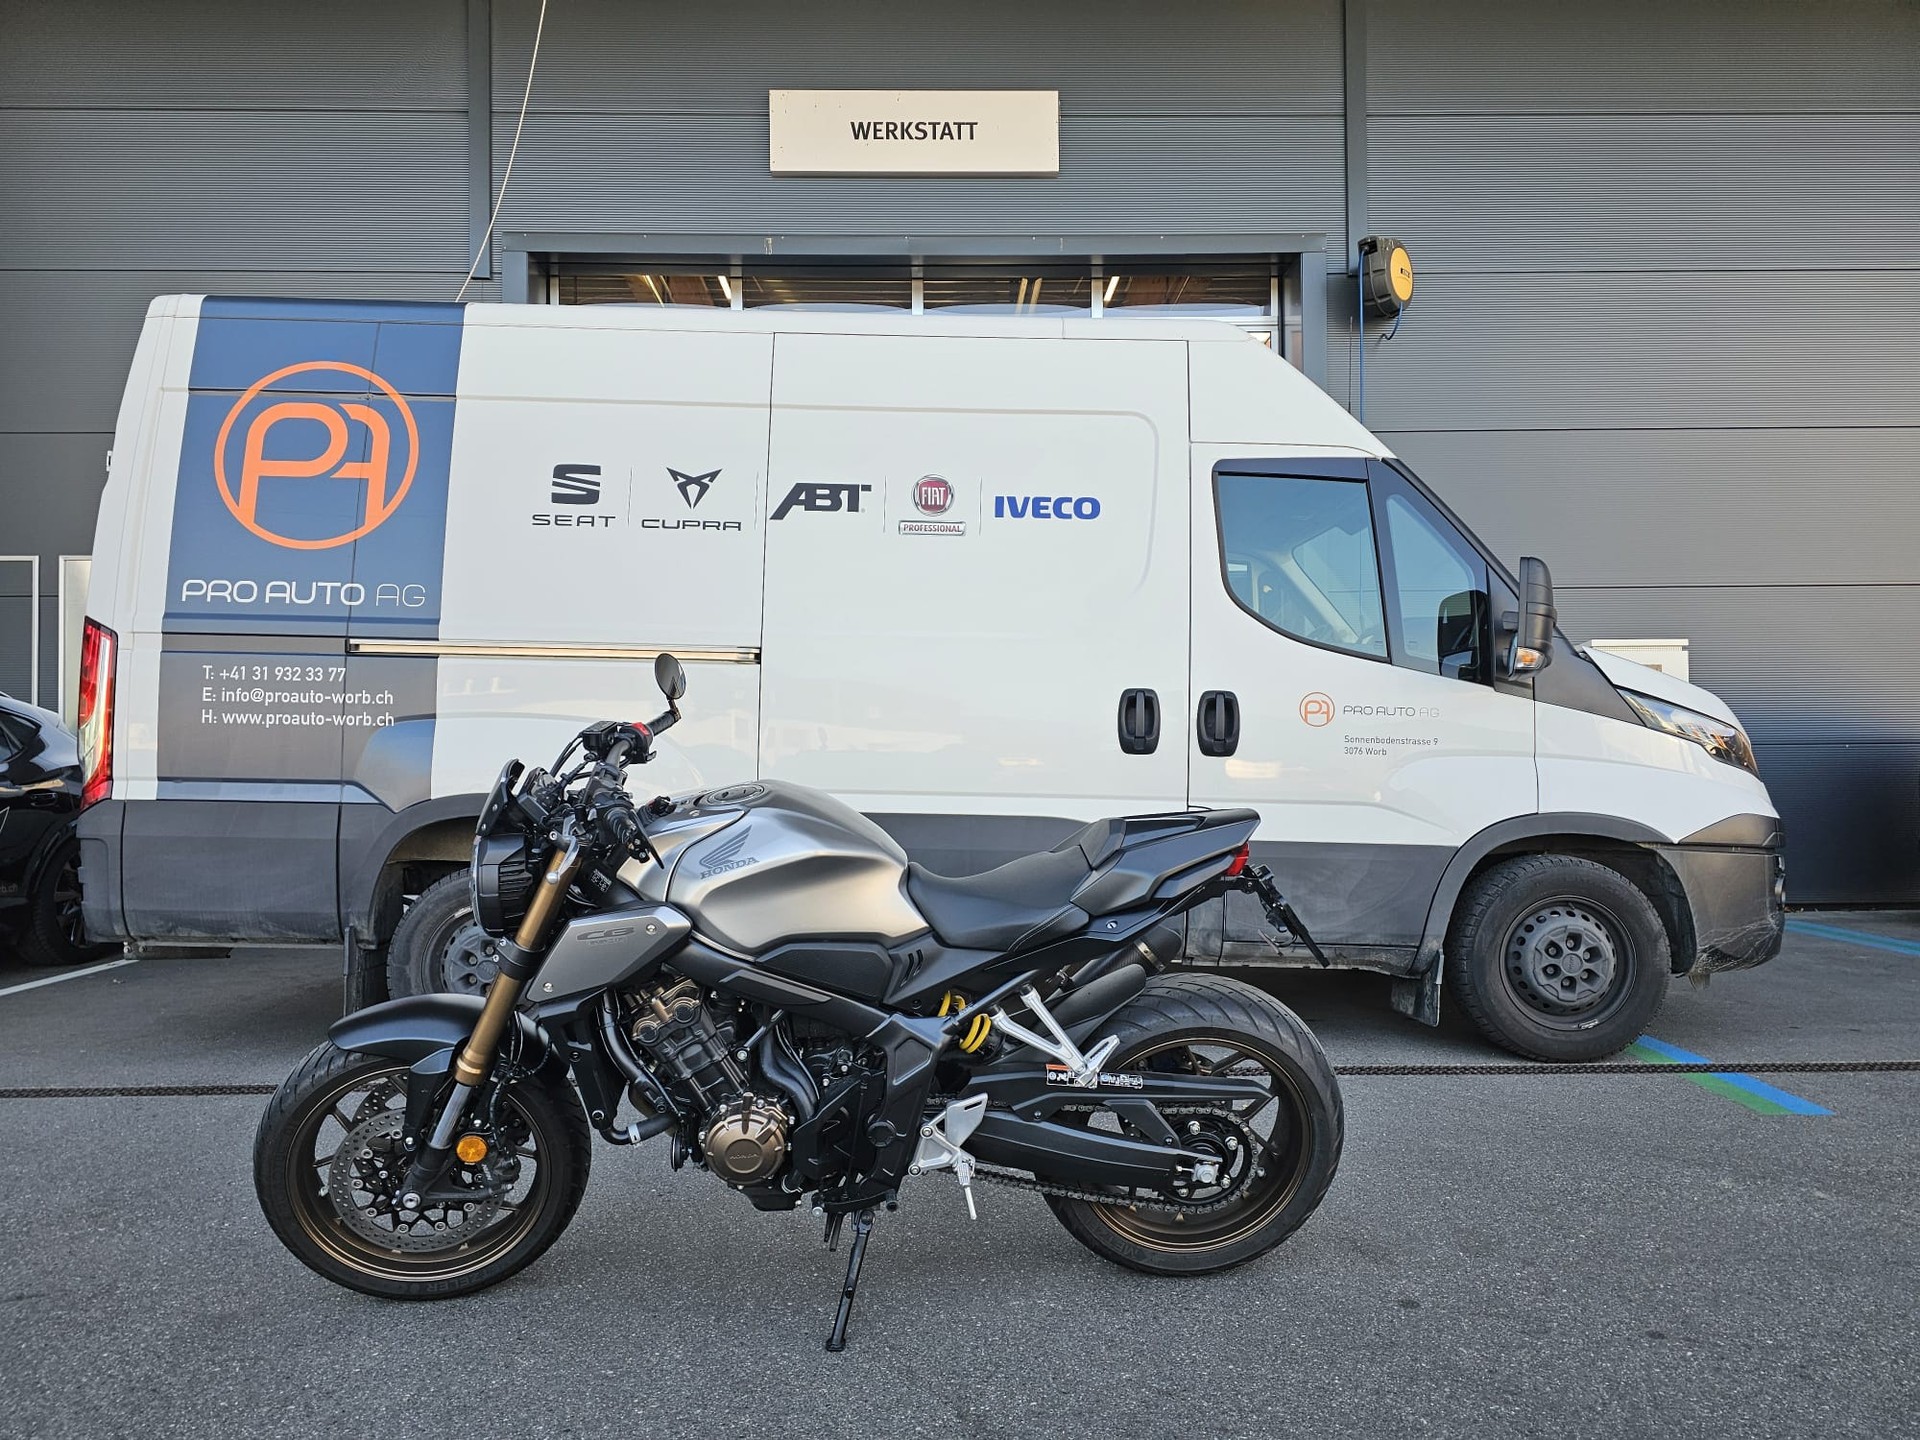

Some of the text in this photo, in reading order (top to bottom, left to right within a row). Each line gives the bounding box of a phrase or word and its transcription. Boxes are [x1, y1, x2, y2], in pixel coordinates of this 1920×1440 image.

[850, 121, 978, 140] WERKSTATT
[769, 482, 872, 520] ABT
[921, 486, 946, 506] FIAT
[994, 495, 1101, 520] IVECO
[531, 514, 617, 528] SEAT
[641, 518, 742, 531] CUPRA
[903, 524, 963, 533] PROFESSIONAL
[181, 579, 426, 607] PRO AUTO AG
[202, 665, 347, 682] T: +41 31 932 33 77
[202, 687, 394, 706] E: info@proauto-worb.ch
[201, 709, 395, 728] H: www.proauto-worb.ch
[1343, 705, 1440, 718] PRO AUTO AG
[1344, 735, 1439, 746] Sonnenbodenstrasse 9
[1344, 747, 1387, 756] 3076 Worb
[700, 857, 760, 880] HONDA
